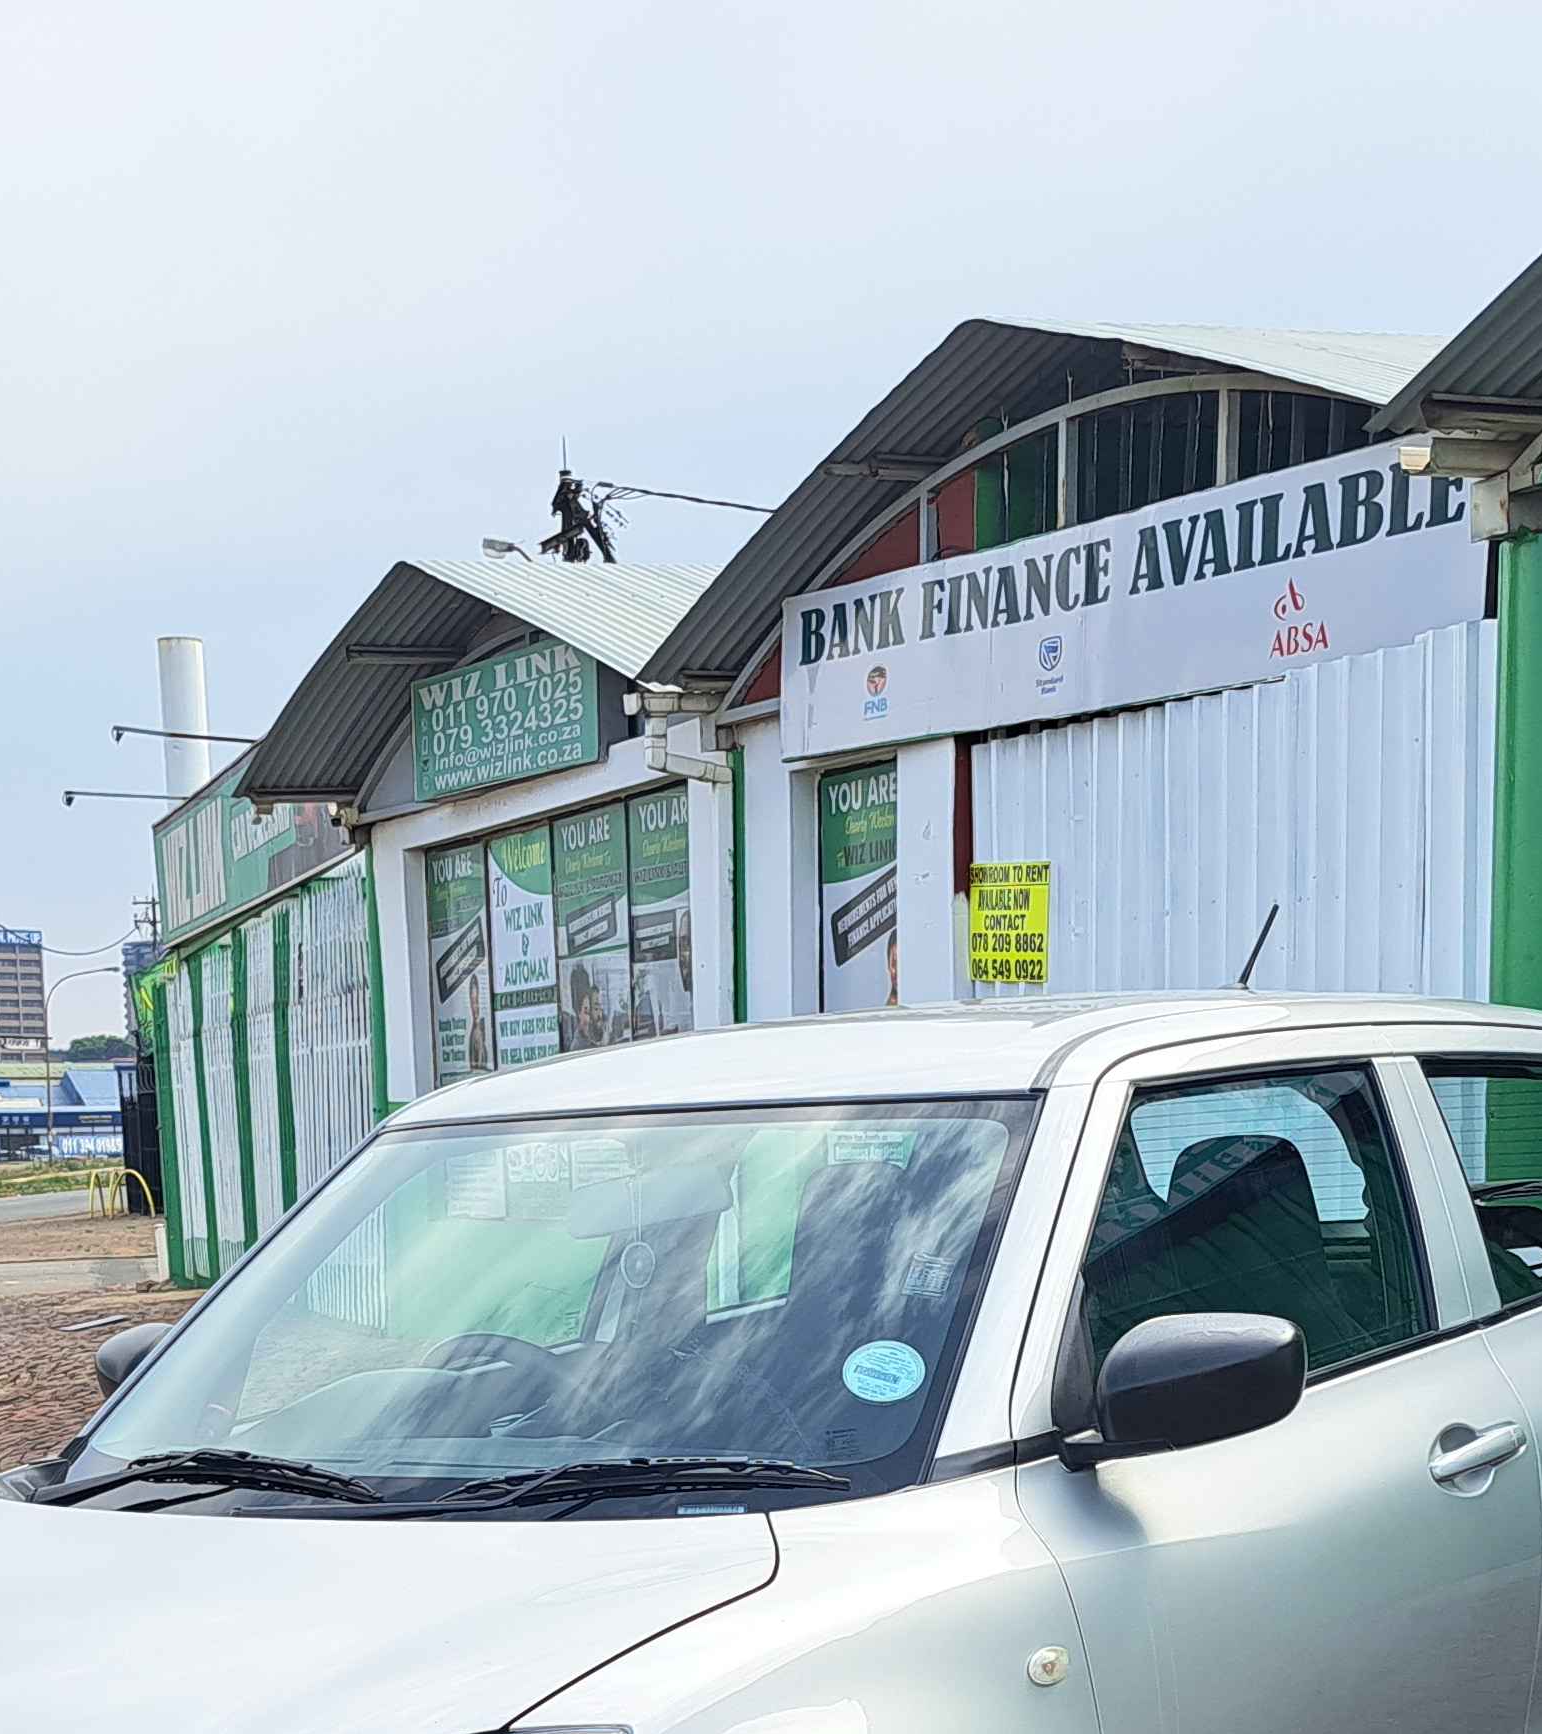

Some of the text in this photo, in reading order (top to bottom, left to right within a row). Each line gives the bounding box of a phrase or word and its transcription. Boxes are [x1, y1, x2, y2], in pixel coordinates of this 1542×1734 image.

[799, 462, 1466, 667] BANK FINANCE AVAILABLE
[1270, 621, 1330, 659] ABSA
[418, 643, 582, 711] WIZ LINK
[1035, 675, 1064, 688] Standard
[432, 667, 582, 732] 011 970 7025
[864, 697, 888, 716] FNB
[433, 694, 583, 756] 079 3324325
[434, 723, 581, 772] info@wizlink.co.za
[434, 742, 582, 791] www.wizlink.co.za
[828, 772, 898, 815] YOU ARE
[638, 796, 689, 832] YOU AR
[561, 814, 610, 851] YOU ARE
[431, 852, 473, 883] YOU ARE
[503, 839, 546, 874] Welcome
[843, 844, 866, 867] WIZ
[970, 864, 1050, 885] SHOWROOM TO RENT
[492, 876, 508, 908] To
[978, 887, 1031, 912] AVAILABLE NOW
[503, 906, 522, 932] WIZ
[524, 901, 545, 929] LINK
[984, 914, 1027, 931] CONTACT
[971, 932, 1044, 953] 078 209 8862
[504, 957, 550, 987] AUTOMAX
[971, 958, 1044, 981] 064 549 0922
[522, 1018, 535, 1034] CARS
[547, 1016, 558, 1032] CAS
